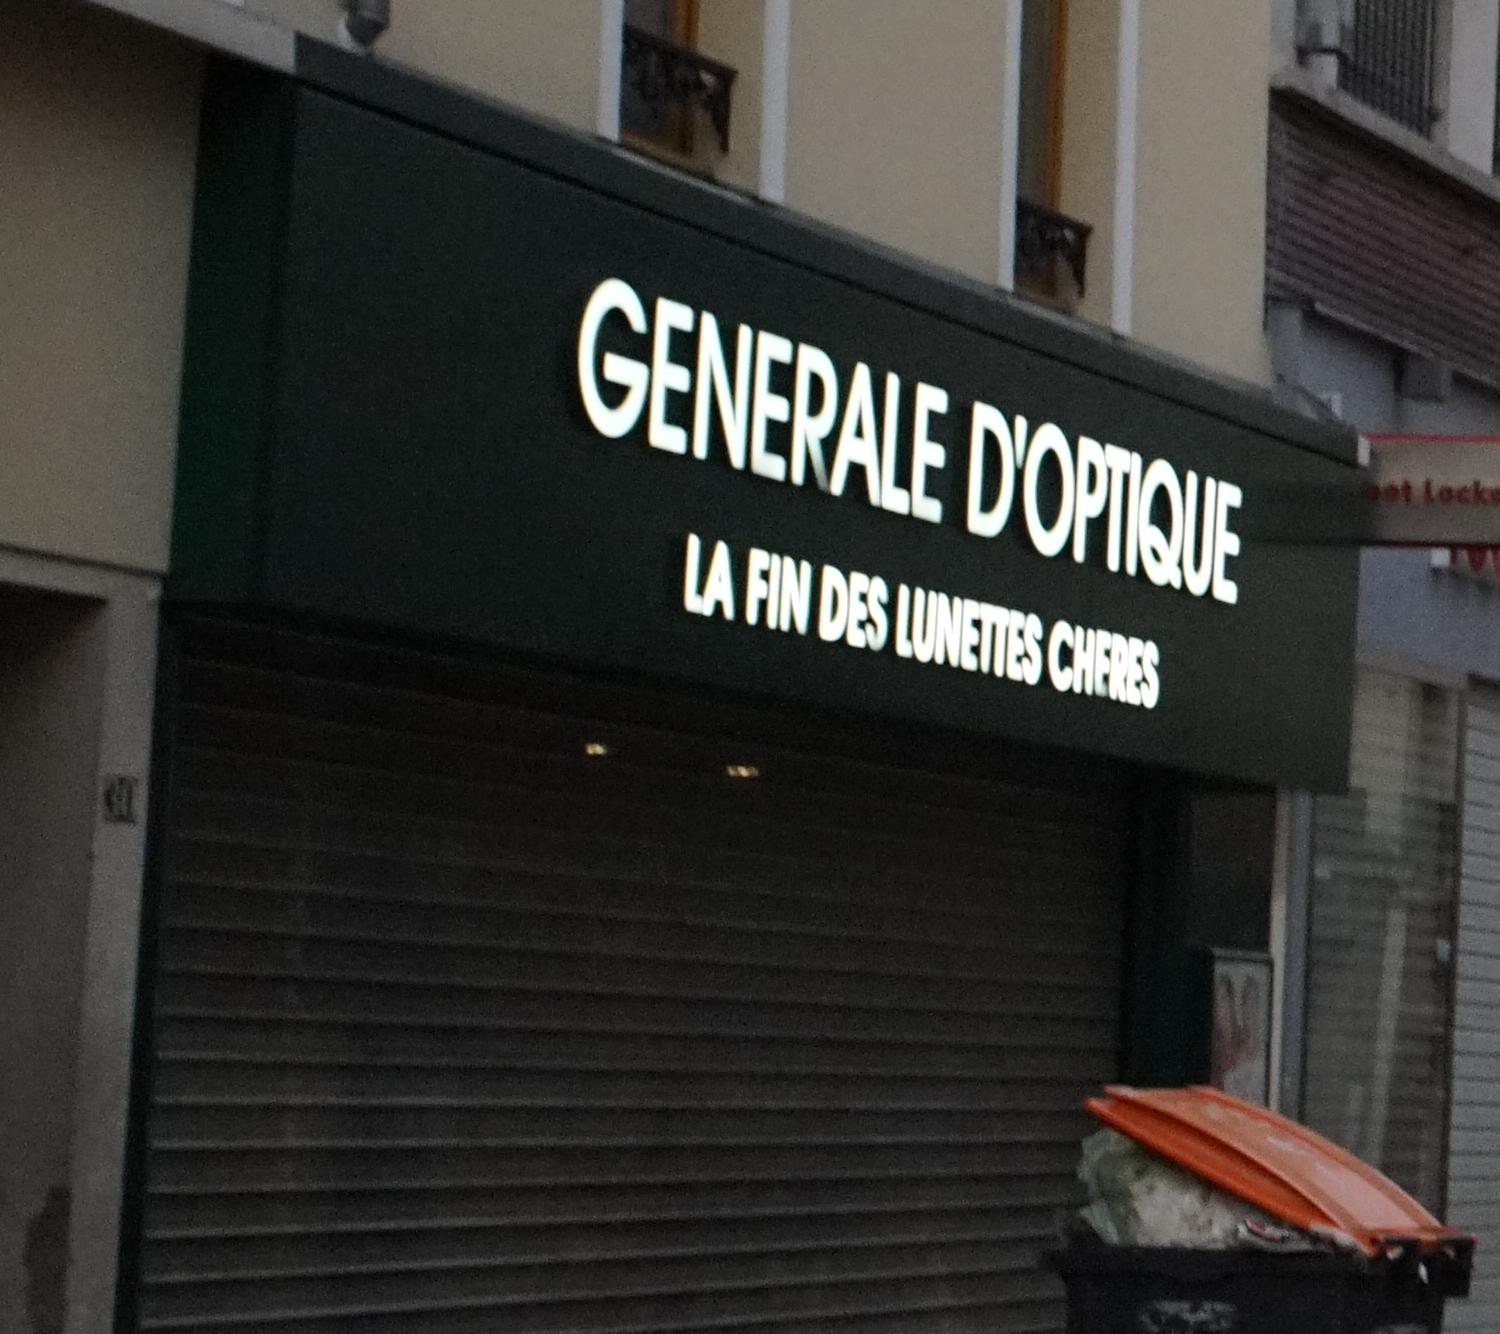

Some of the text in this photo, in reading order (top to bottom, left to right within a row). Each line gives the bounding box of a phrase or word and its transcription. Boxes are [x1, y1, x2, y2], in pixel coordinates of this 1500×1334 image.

[577, 277, 1243, 605] GENERALE D'OPTIQUE
[682, 532, 1161, 711] LA FIN DES LUNETTES CHERES
